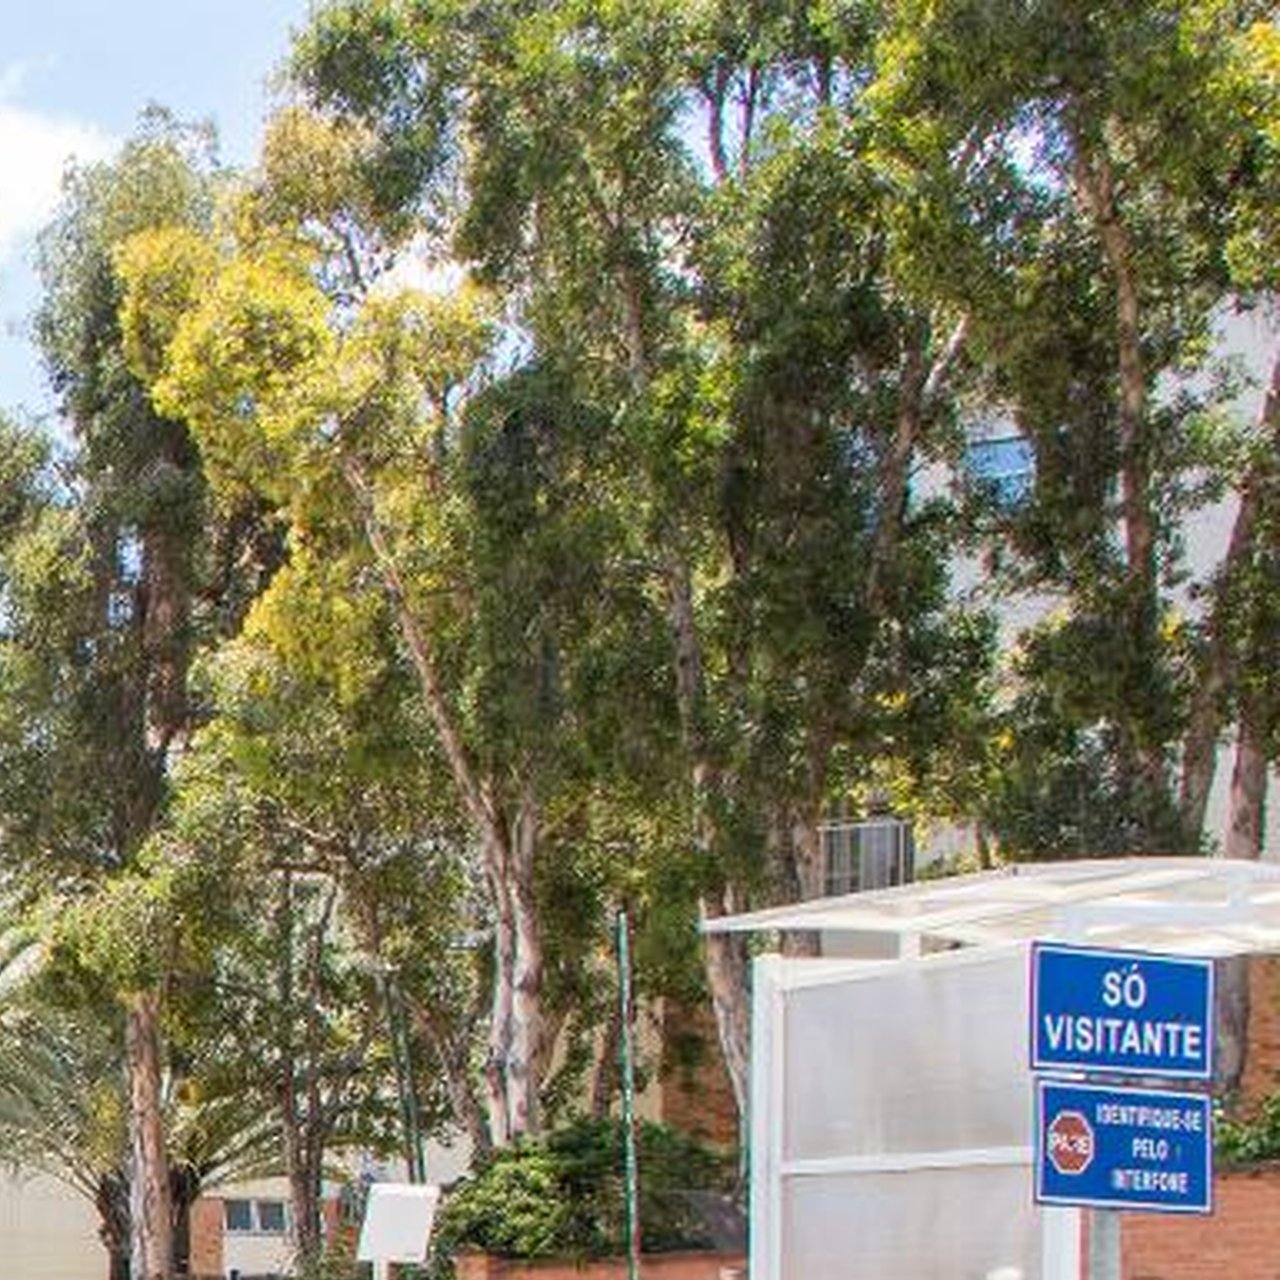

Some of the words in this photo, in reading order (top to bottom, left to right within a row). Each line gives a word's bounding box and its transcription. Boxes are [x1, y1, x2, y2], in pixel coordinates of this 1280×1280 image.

[1102, 963, 1146, 1009] SÓ
[1044, 1015, 1202, 1059] VISITANTE
[1095, 1103, 1203, 1131] IDENTIFIQUE-SE
[1131, 1138, 1169, 1161] PELO
[1112, 1168, 1189, 1193] INTERFONE
